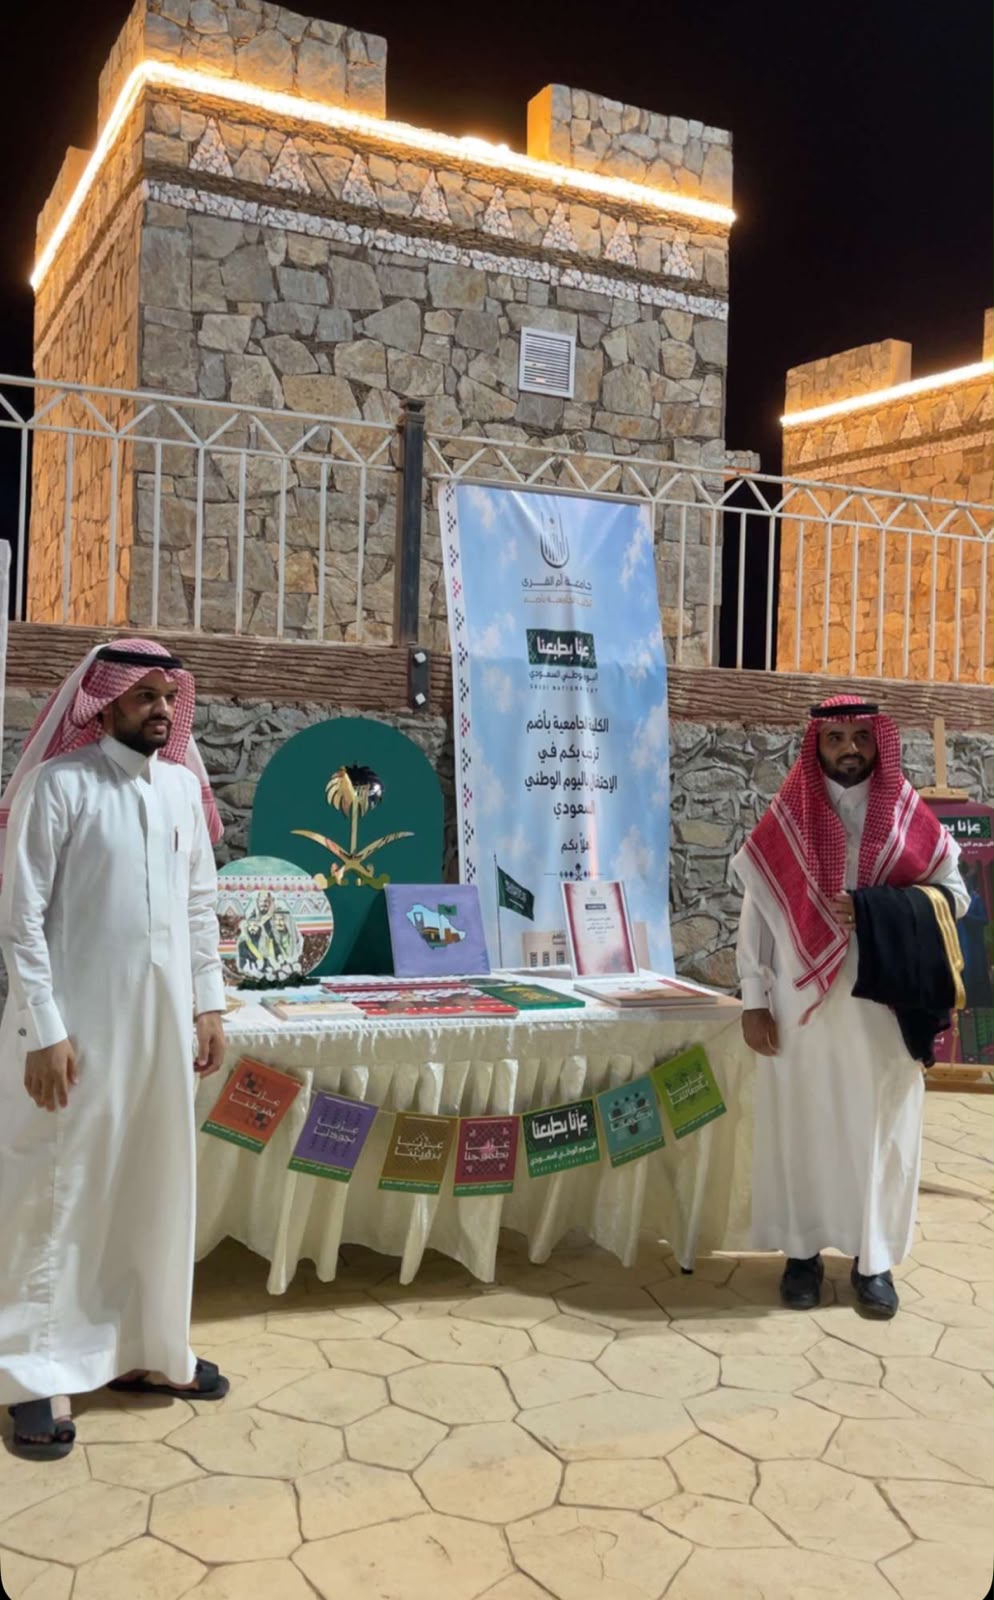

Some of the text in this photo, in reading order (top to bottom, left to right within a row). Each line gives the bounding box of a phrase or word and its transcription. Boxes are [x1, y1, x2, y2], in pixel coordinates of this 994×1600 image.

[521, 574, 592, 590] جامعة أم القرى
[536, 636, 574, 661] بطبعنا
[526, 709, 552, 734] بأضم
[537, 741, 558, 763] في
[559, 744, 580, 762] بكم
[525, 770, 561, 791] الوطني
[957, 819, 981, 836] عزنا
[560, 838, 579, 854] بكم
[531, 1115, 569, 1143] بطبعنا
[463, 1149, 510, 1162] بطموحنا
